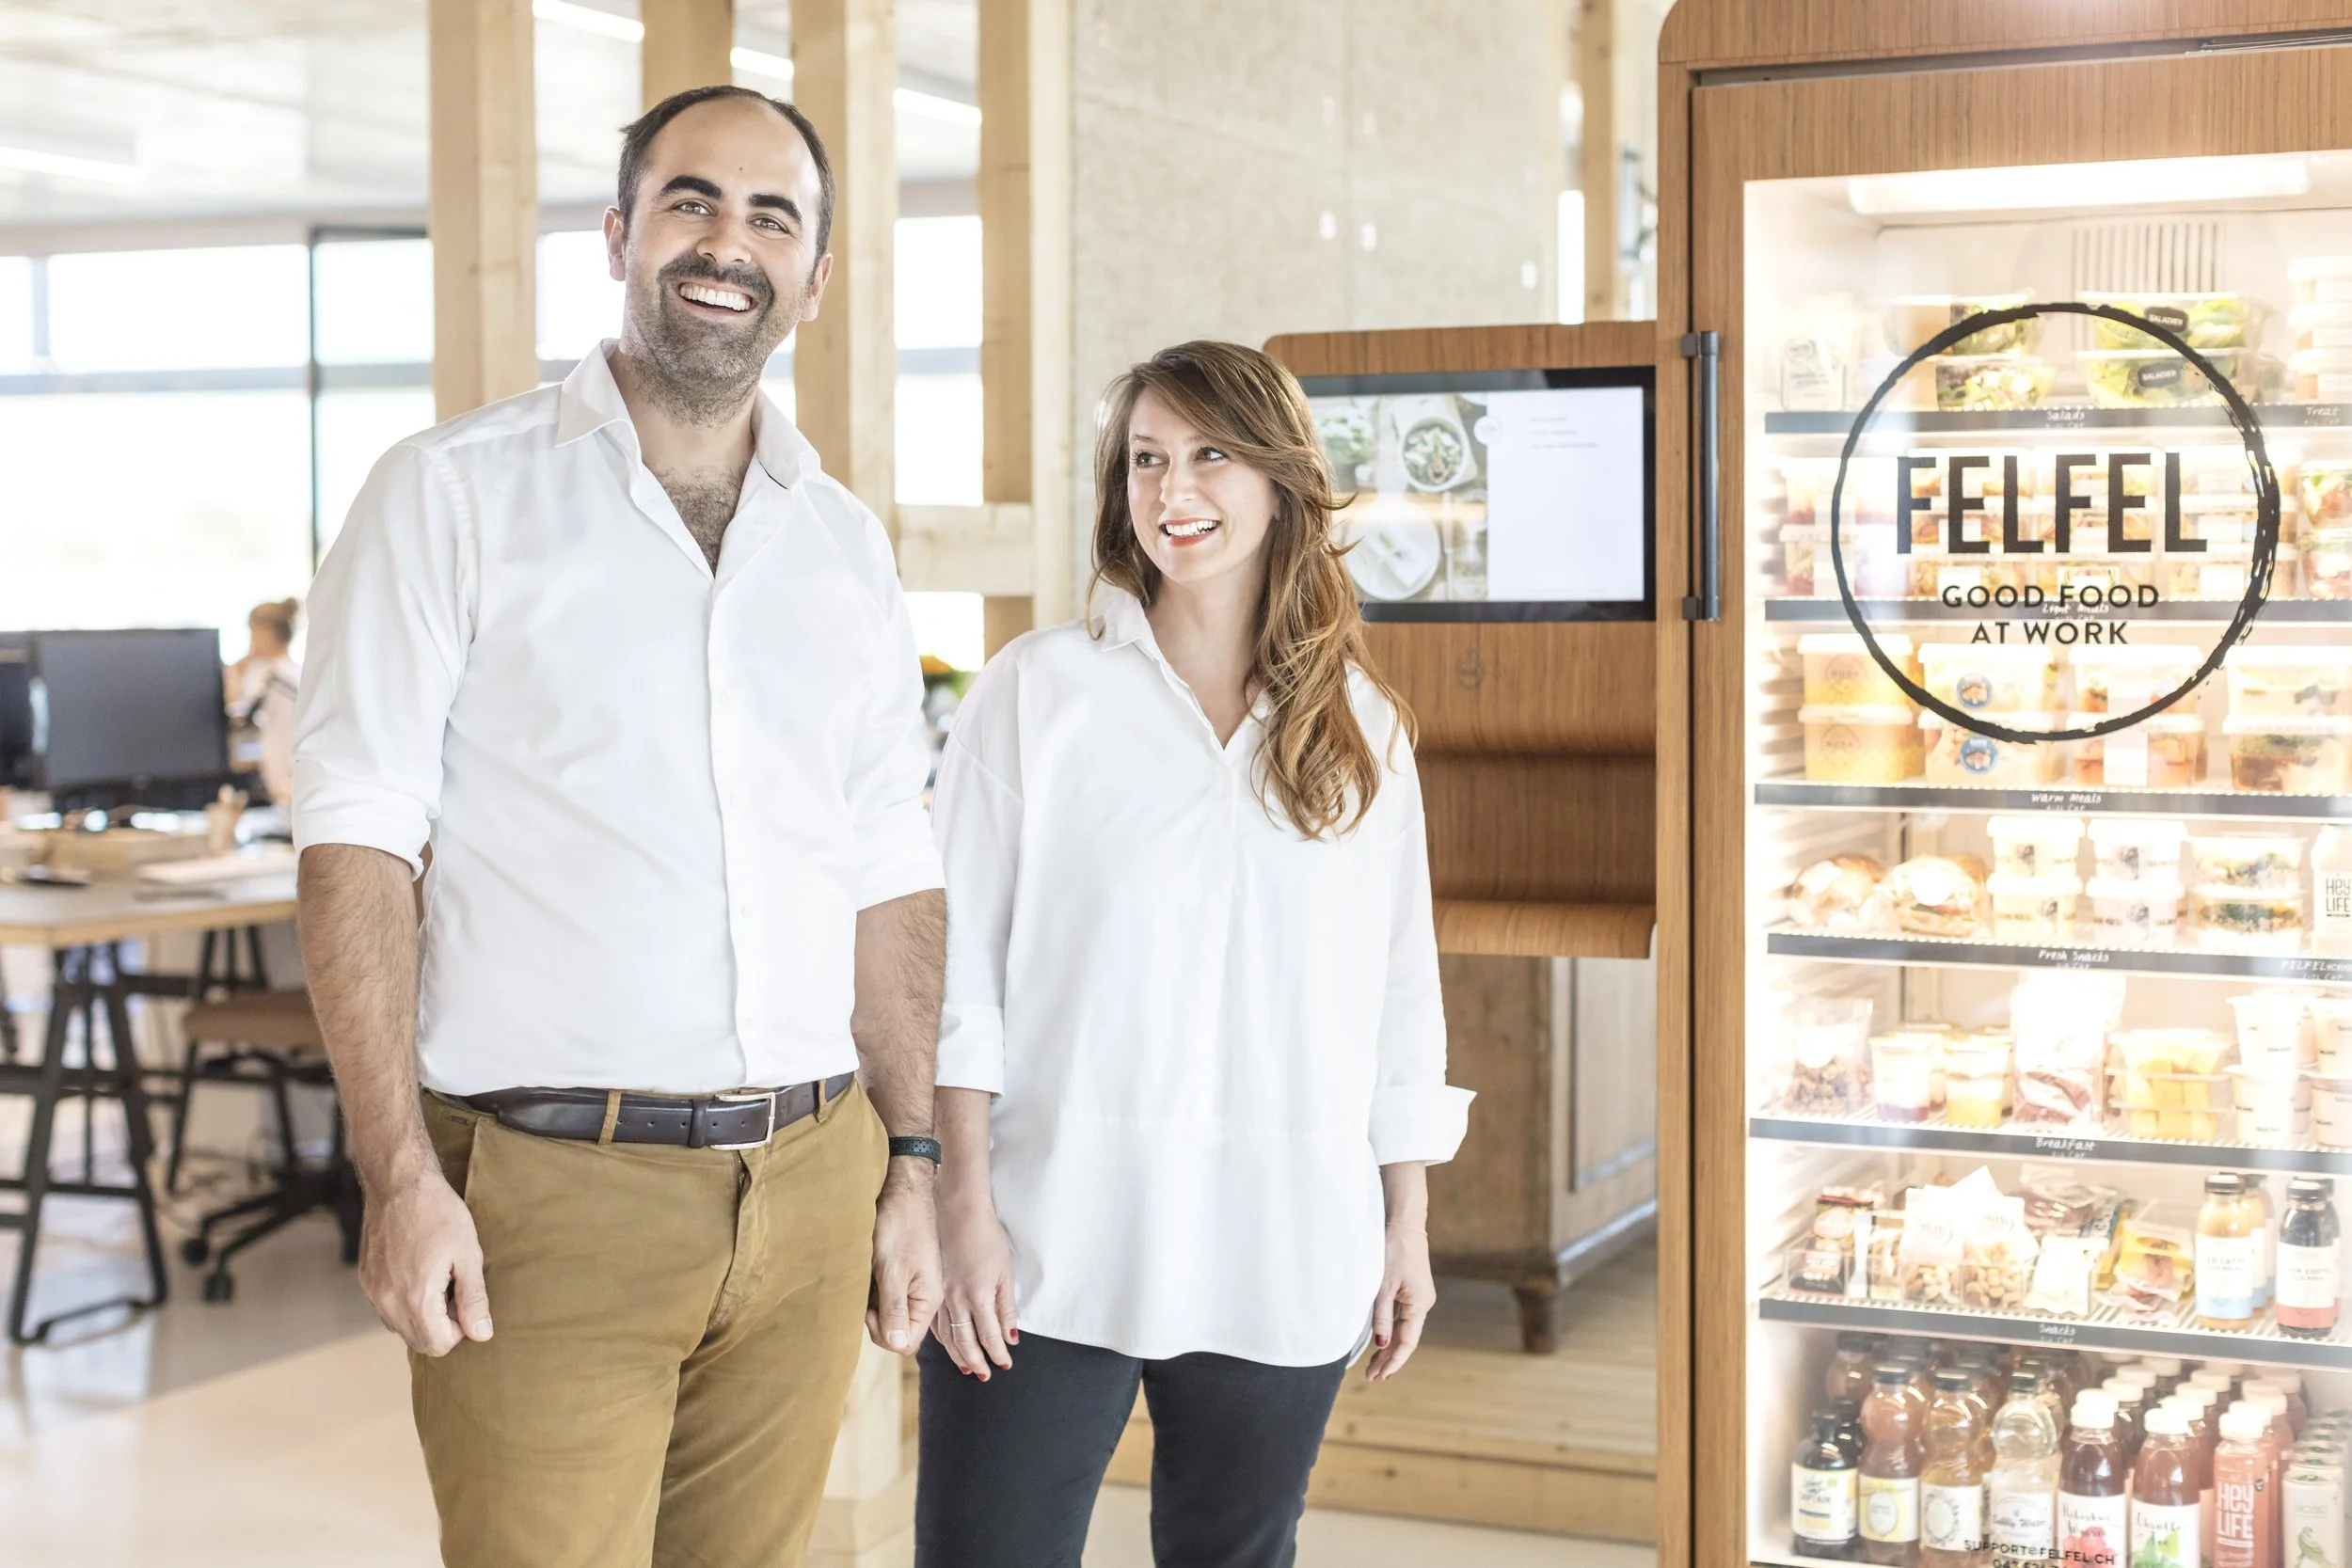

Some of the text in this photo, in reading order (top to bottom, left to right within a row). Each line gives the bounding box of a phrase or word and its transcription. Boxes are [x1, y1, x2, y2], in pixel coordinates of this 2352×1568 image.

[1896, 451, 2208, 555] FELFEL
[1941, 583, 2160, 609] GOOD FOOD
[1971, 621, 2129, 645] AT WORK
[2326, 896, 2351, 912] LIFE
[2039, 948, 2068, 960] Fresh
[2217, 1511, 2255, 1540] LIFE
[1964, 1540, 2116, 1565] SUPPORT@FELFEL.CH
